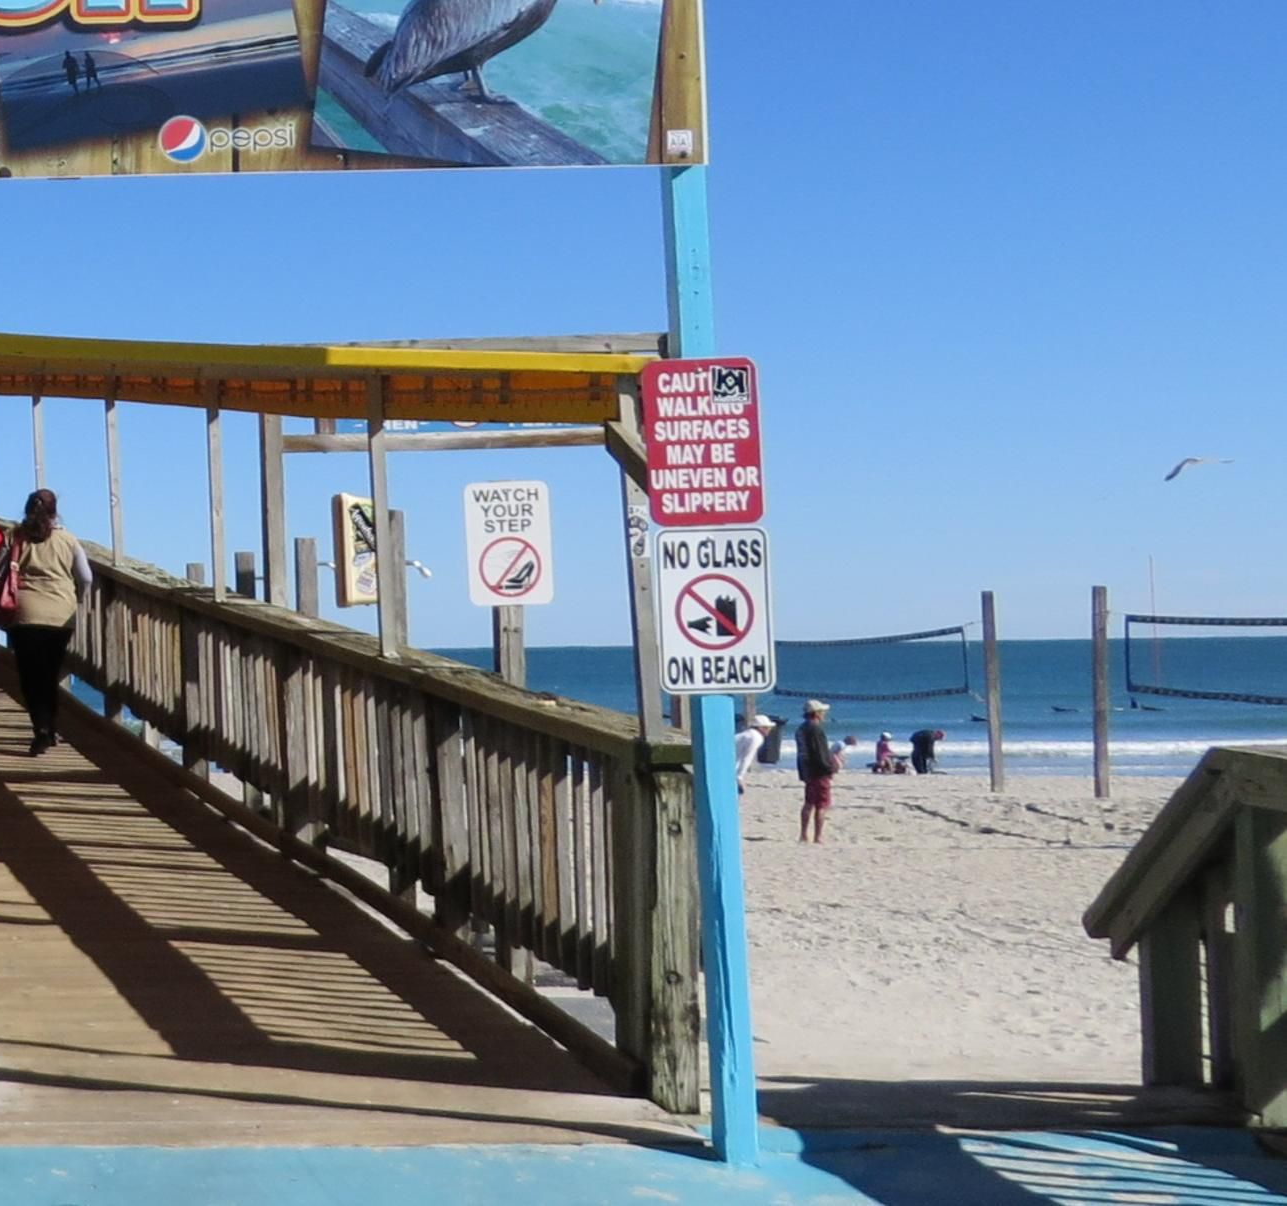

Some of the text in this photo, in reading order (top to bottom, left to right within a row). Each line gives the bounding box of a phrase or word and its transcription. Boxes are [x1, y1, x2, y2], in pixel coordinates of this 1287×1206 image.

[209, 121, 295, 153] pepsi
[654, 419, 750, 441] SURFACES
[666, 443, 735, 465] MAY BE
[650, 466, 759, 490] UNEVEN OR
[473, 488, 539, 502] WATCH
[661, 491, 750, 514] SLIPPERY
[481, 504, 533, 517] YOUR
[484, 519, 531, 533] STEP
[663, 538, 762, 569] NO GLASS
[667, 655, 766, 685] ON BEACH
